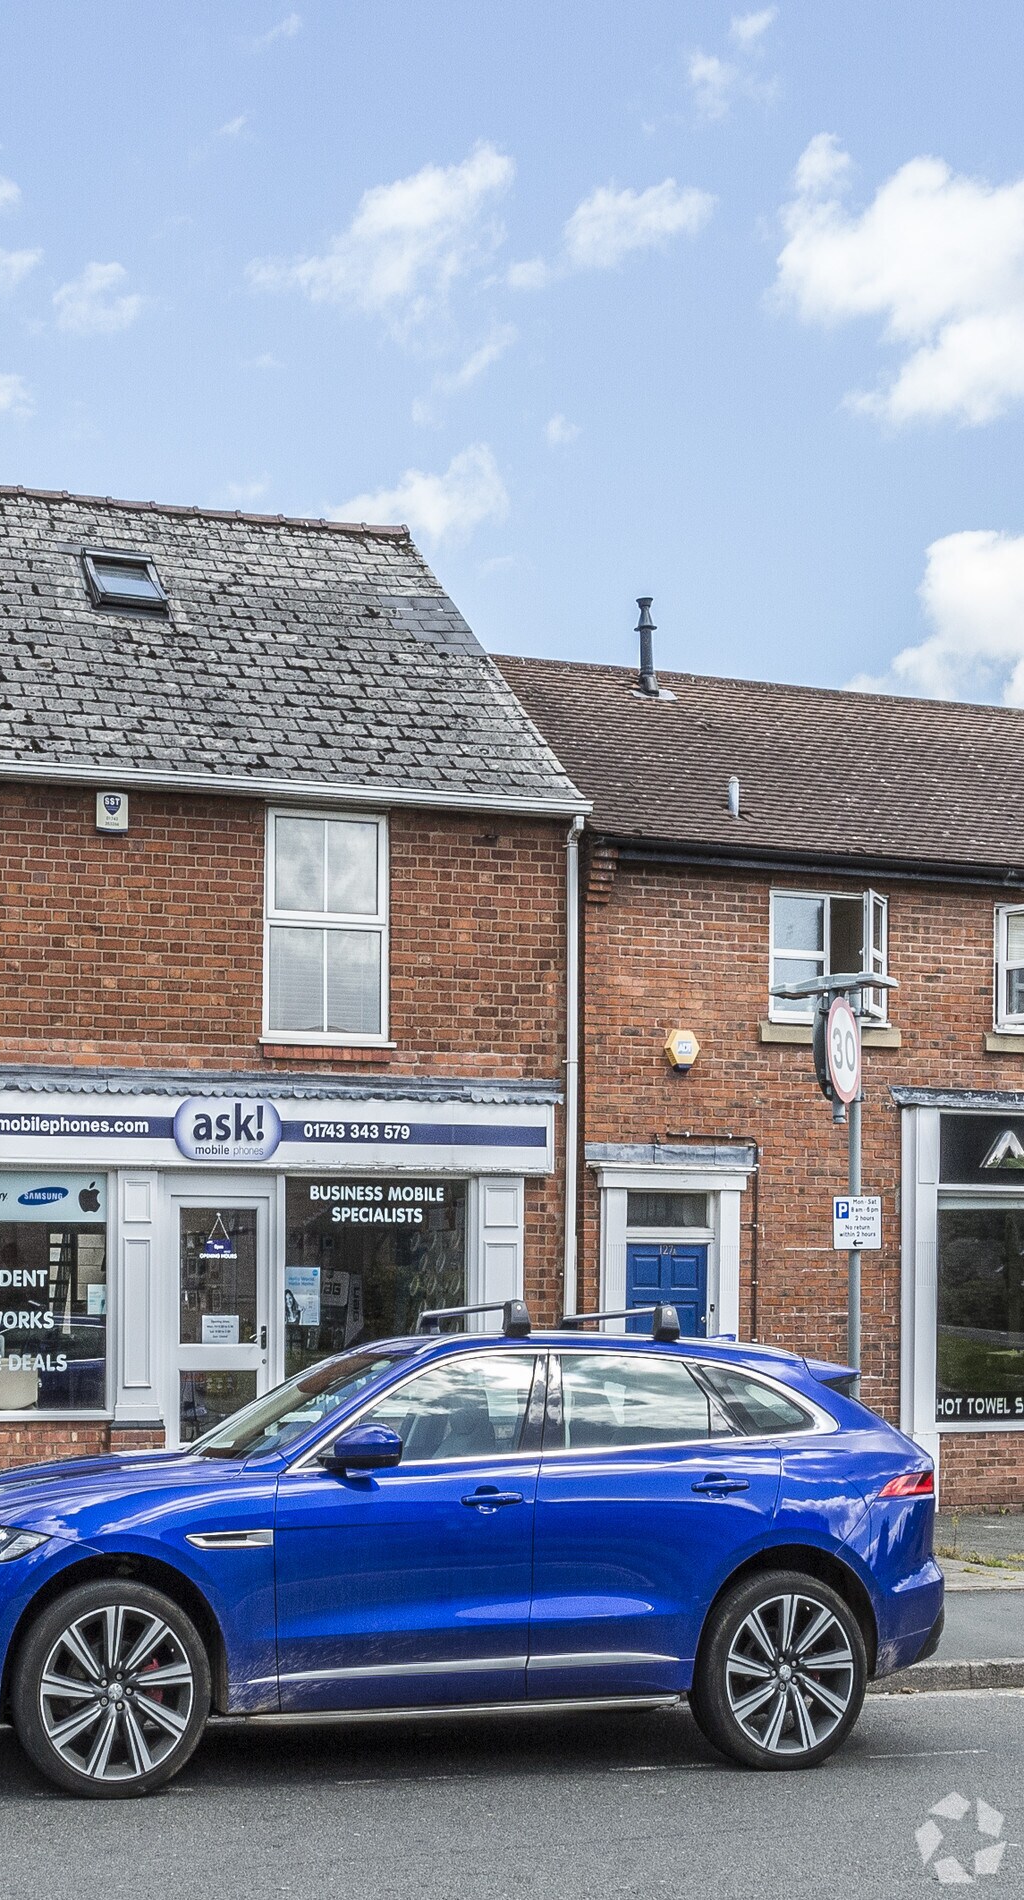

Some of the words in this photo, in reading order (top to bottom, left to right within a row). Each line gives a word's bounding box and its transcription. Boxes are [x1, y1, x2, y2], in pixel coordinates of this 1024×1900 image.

[105, 797, 120, 806] SST
[833, 1027, 856, 1072] 30
[192, 1103, 265, 1142] ask!
[304, 1123, 346, 1139] 01743
[350, 1124, 380, 1139] 343
[384, 1125, 411, 1140] 579
[195, 1145, 230, 1156] mobile
[233, 1145, 264, 1157] phones
[24, 1192, 63, 1201] SAMSUNG
[309, 1185, 383, 1202] BUSINESS
[388, 1186, 445, 1202] MOBILE
[332, 1207, 423, 1223] SPECIALISTS
[8, 1354, 68, 1372] DEALS
[936, 1398, 963, 1415] HOT
[967, 1397, 1011, 1415] TOWEL
